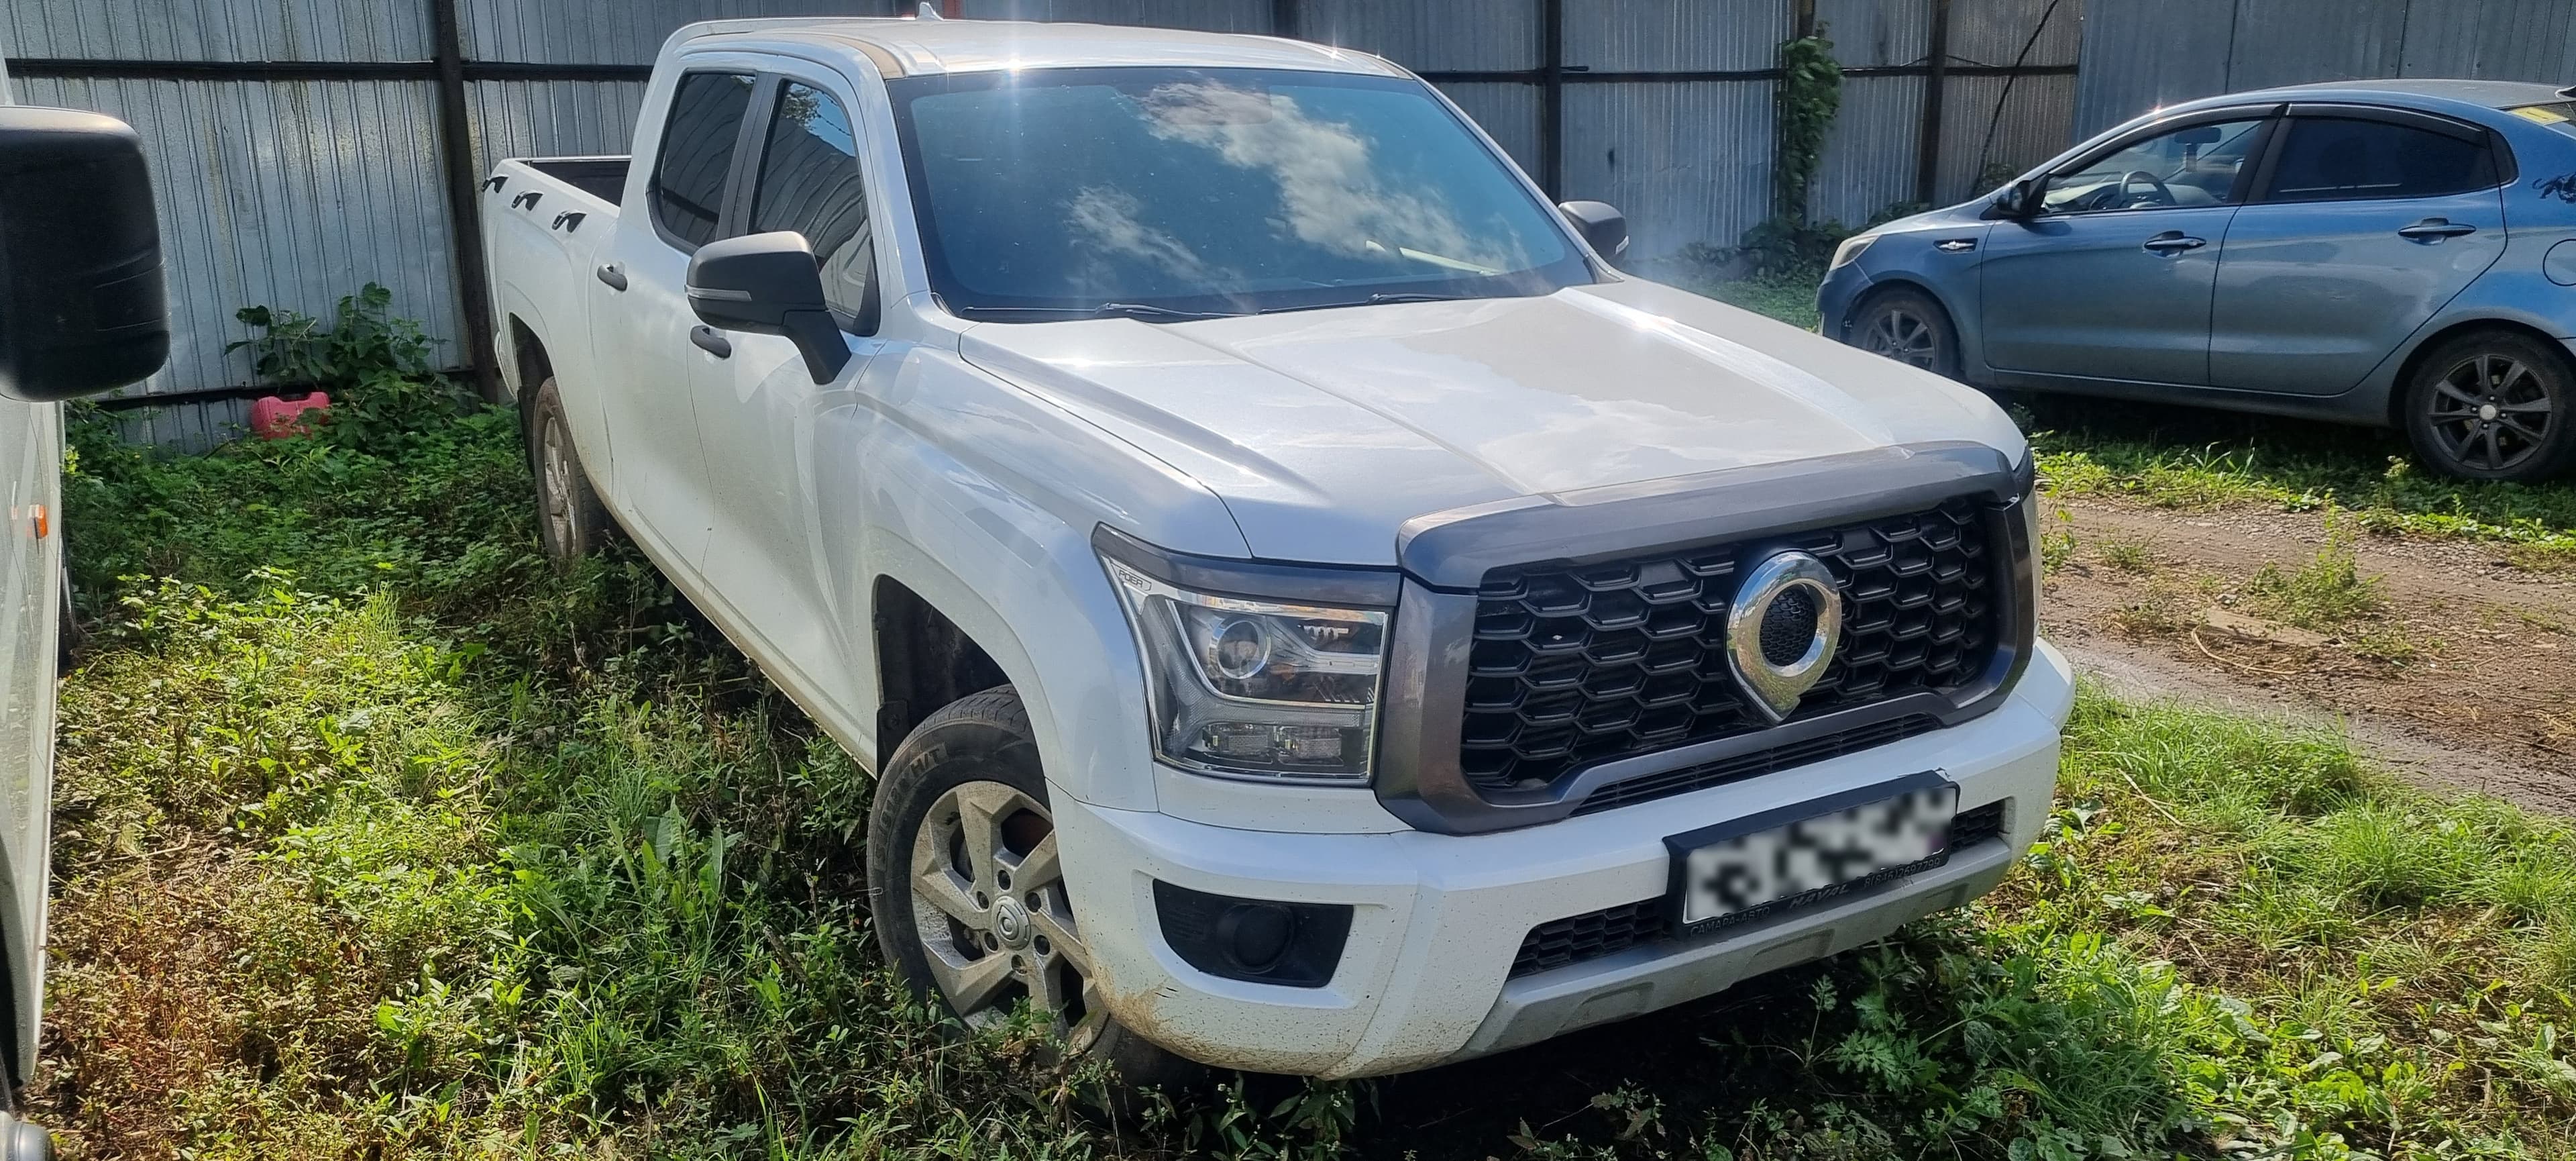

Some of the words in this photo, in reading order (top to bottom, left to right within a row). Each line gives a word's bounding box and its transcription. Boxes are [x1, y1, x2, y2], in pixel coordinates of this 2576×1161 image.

[1118, 570, 1143, 588] POER
[910, 748, 940, 777] H/T
[1690, 906, 1770, 937] САМАРА-АВТО
[1788, 884, 1849, 909] HAVAL
